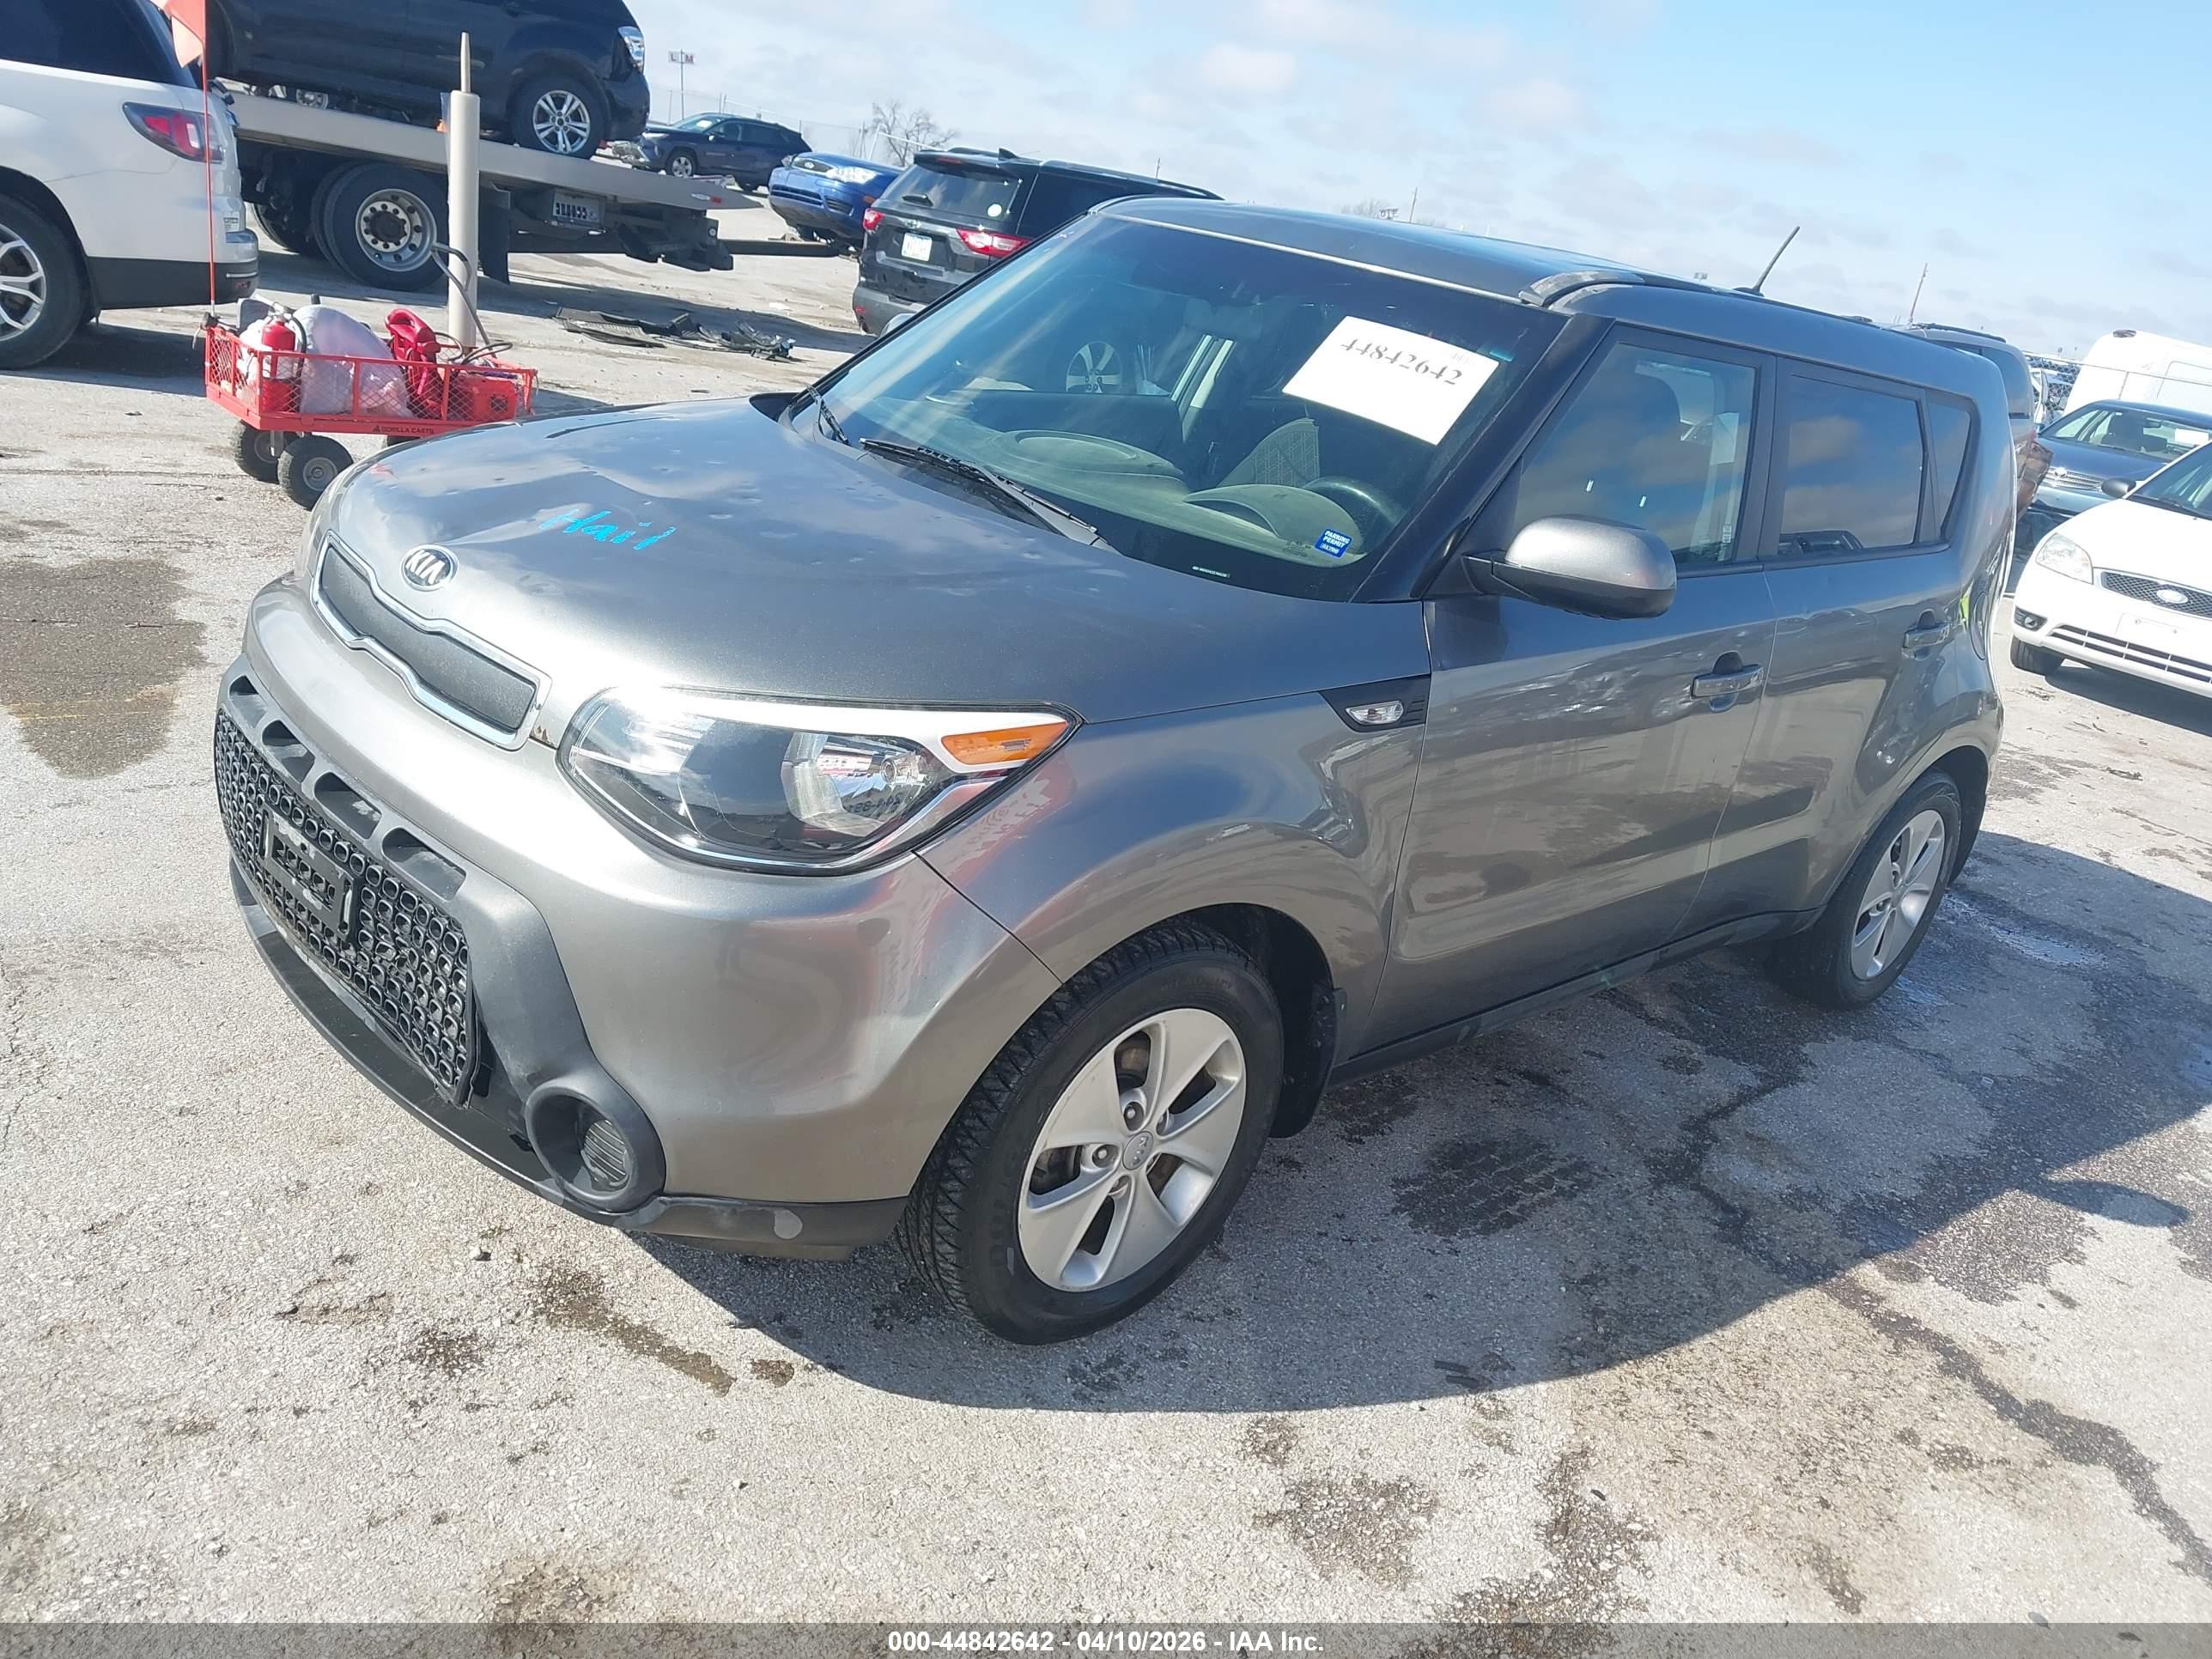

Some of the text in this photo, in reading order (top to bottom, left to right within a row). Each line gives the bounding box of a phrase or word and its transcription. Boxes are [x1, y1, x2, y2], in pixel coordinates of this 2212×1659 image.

[1340, 338, 1462, 385] 44842642
[538, 508, 677, 550] Hail
[1322, 535, 1346, 549] PERMIT
[1324, 530, 1351, 544] PARKING
[404, 549, 447, 586] KIA
[1130, 1135, 1149, 1167] KIA
